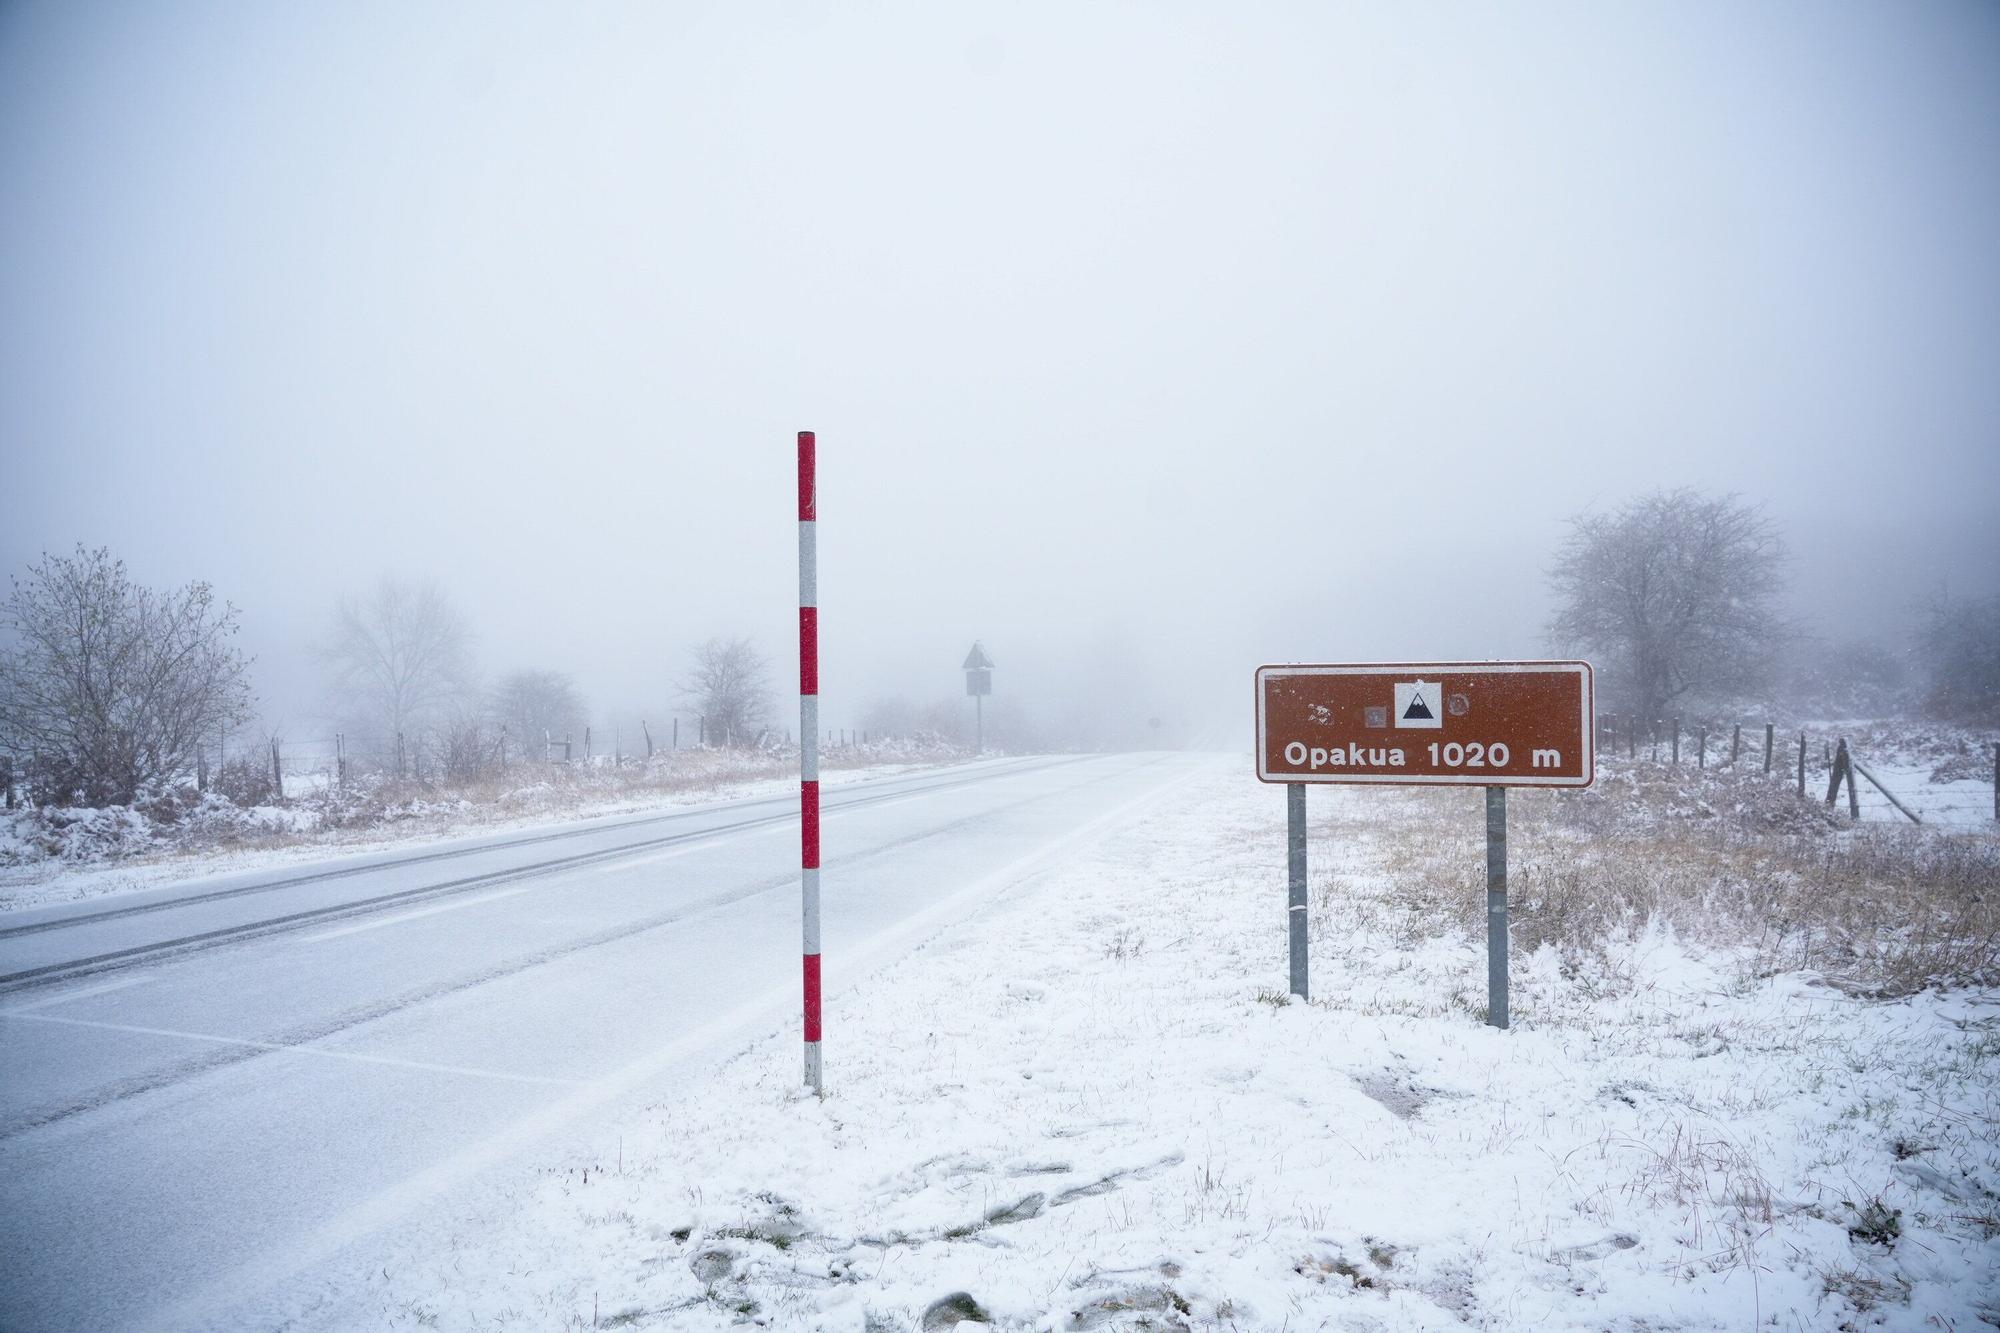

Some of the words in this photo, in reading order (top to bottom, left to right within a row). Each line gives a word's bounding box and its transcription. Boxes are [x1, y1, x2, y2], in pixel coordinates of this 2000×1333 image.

[1284, 741, 1406, 769] Opakua
[1427, 742, 1510, 767] 1020
[1533, 748, 1561, 768] m
